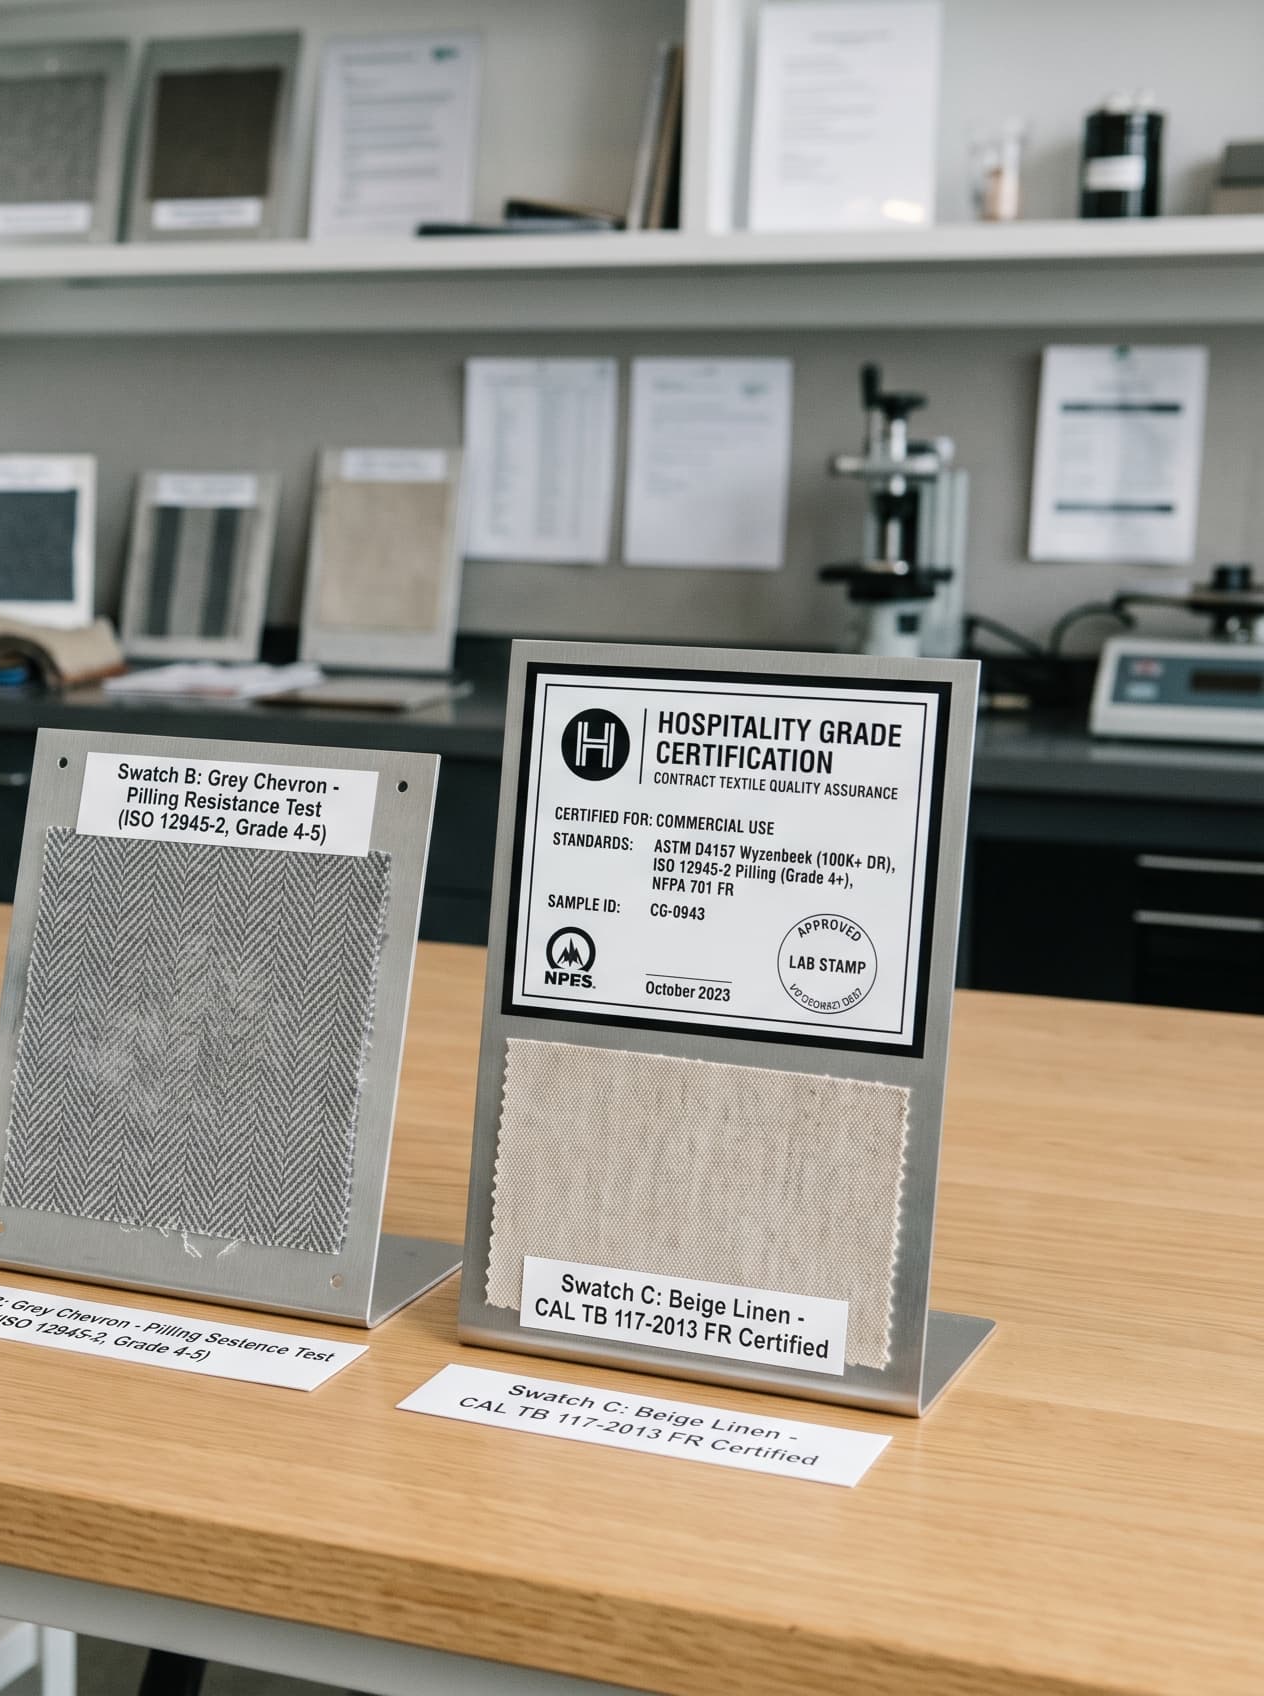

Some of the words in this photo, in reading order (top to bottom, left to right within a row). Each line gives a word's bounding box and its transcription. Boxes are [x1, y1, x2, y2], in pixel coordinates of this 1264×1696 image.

[658, 711, 812, 742] HOSPITALITY
[819, 720, 902, 748] GRADE
[656, 740, 833, 774] CERTIFICATION
[118, 763, 179, 783] Swatch
[184, 768, 202, 785] B:
[208, 769, 248, 793] Grey
[254, 772, 327, 794] Chevron
[654, 771, 716, 787] CONTRACT
[719, 776, 766, 791] TEXTILE
[769, 779, 821, 795] QUALITY
[824, 783, 898, 800] ASSURANCE
[127, 786, 179, 811] Pilling
[184, 791, 280, 814] Resistance
[286, 798, 322, 818] Test
[118, 809, 154, 830] (ISO
[160, 812, 229, 837] 12945-2,
[236, 818, 288, 839] Grade
[293, 823, 326, 846] 4-5)
[555, 806, 619, 824] CERTIFIED
[623, 811, 653, 826] FOR:
[656, 813, 744, 833] COMMERCIAL
[749, 820, 775, 835] USE
[553, 832, 633, 851] STANDARDS:
[654, 839, 691, 855] ASTM
[695, 842, 736, 858] D4157
[740, 845, 812, 864] Wyzenbeek
[816, 851, 862, 869] (100K+
[867, 855, 895, 874] DR),
[652, 876, 686, 892] NFPA
[690, 879, 712, 894] 701
[717, 881, 734, 896] FR
[653, 857, 675, 873] ISO
[680, 860, 731, 877] 12945-2
[735, 864, 776, 884] Pilling
[781, 867, 824, 885] (Grade
[828, 872, 853, 889] 4+),
[548, 894, 600, 911] SAMPLE
[603, 899, 620, 913] ID:
[650, 903, 705, 921] CG-0943
[797, 918, 861, 941] APPROVED
[789, 955, 815, 970] LAB
[819, 957, 866, 975] STAMP
[646, 981, 696, 998] October
[698, 986, 730, 1002] 2023
[561, 1274, 634, 1302] Swatch
[641, 1285, 661, 1306] C:
[669, 1289, 726, 1318] Beige
[733, 1298, 790, 1325] Linen
[11, 1300, 55, 1317] Grey
[56, 1308, 130, 1328] Chevron
[142, 1322, 203, 1343] Pilling
[295, 1347, 334, 1362] Test
[535, 1297, 575, 1321] CAL
[582, 1304, 607, 1325] TB
[615, 1309, 697, 1339] 117-2013
[704, 1322, 732, 1344] FR
[739, 1327, 829, 1359] Certified
[114, 1336, 170, 1353] Grade
[173, 1346, 211, 1362] 4-5)
[508, 1385, 594, 1408] Swatch
[603, 1401, 628, 1414] C:
[635, 1406, 704, 1427] Beige
[711, 1419, 780, 1439] Linen
[460, 1397, 506, 1414] CAL
[519, 1406, 550, 1420] TB
[559, 1413, 662, 1439] 117-2013
[667, 1432, 704, 1446] FR
[711, 1440, 819, 1465] Certified
